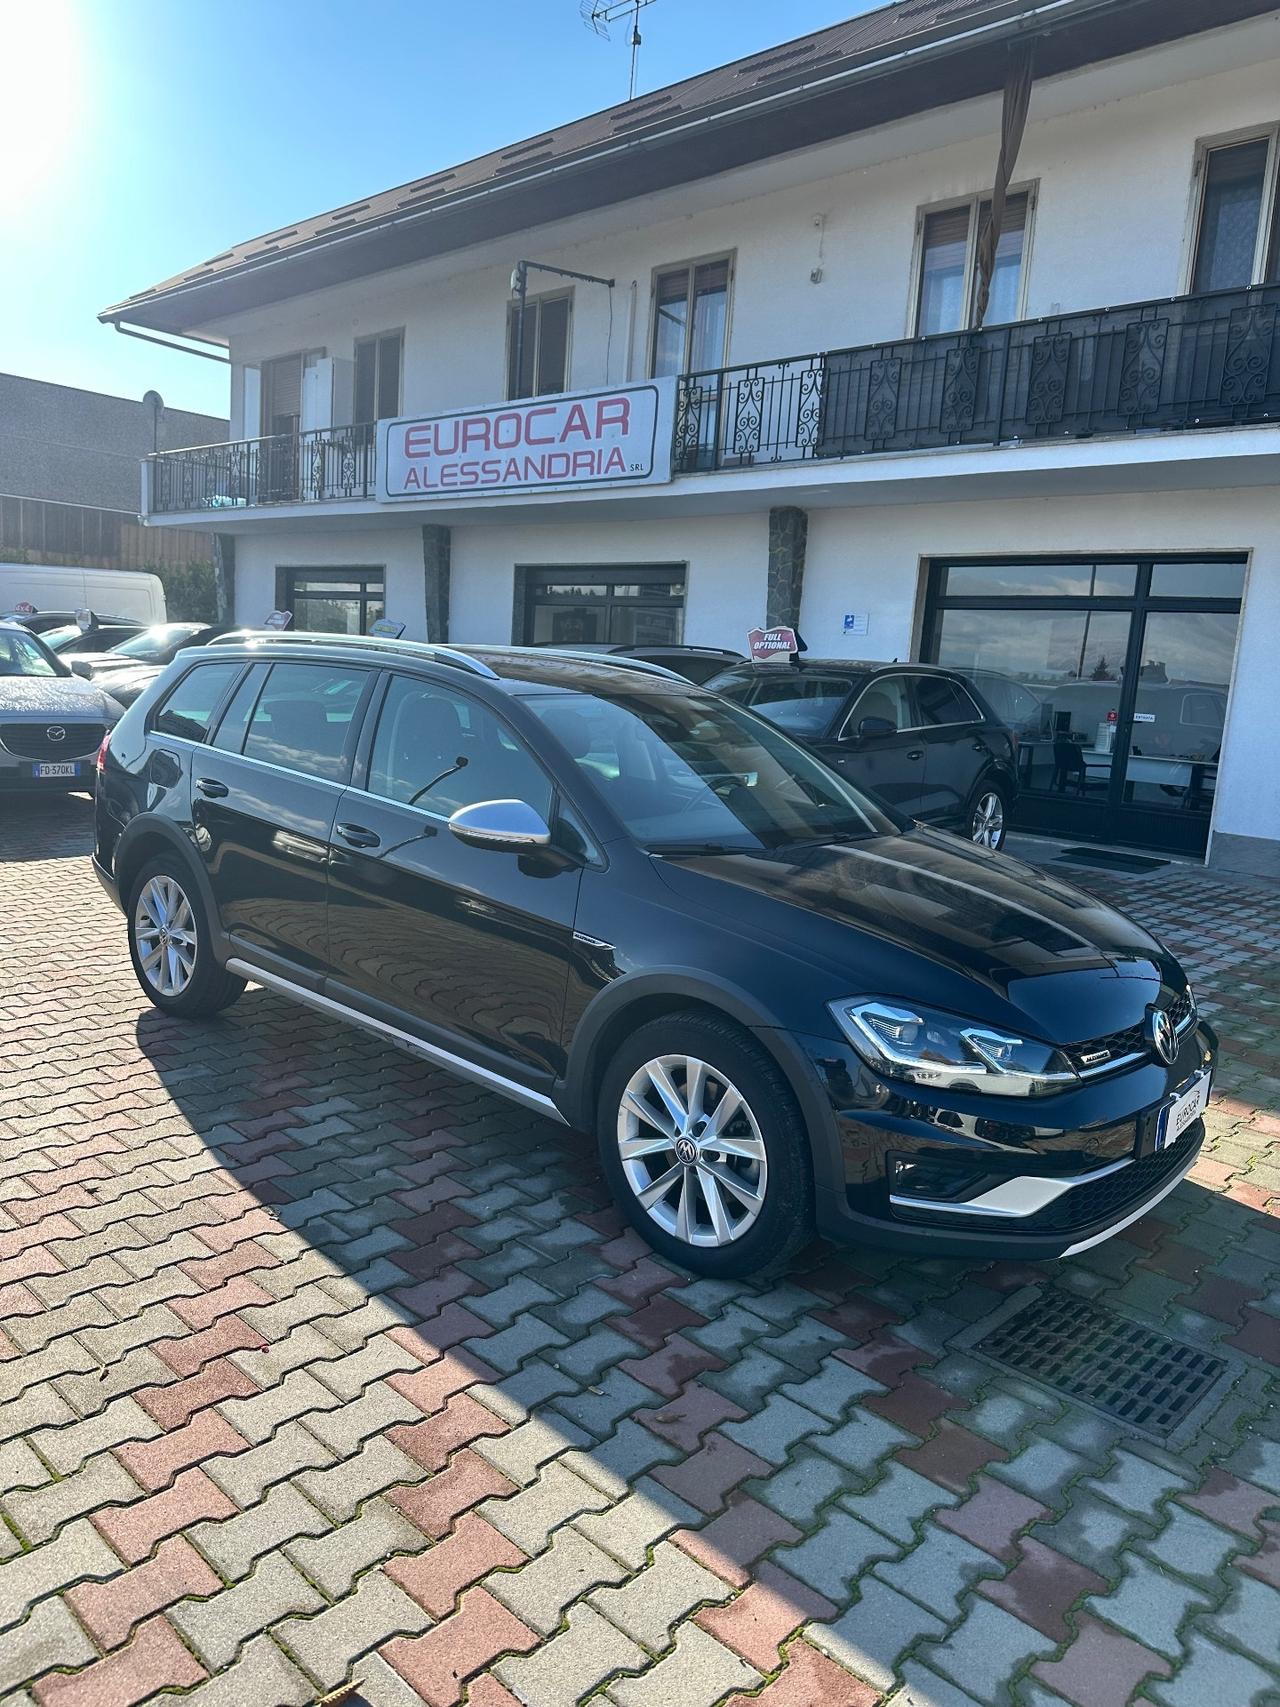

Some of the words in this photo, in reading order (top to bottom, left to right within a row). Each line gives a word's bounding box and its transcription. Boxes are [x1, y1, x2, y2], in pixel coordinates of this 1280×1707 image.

[404, 397, 631, 459] EUROCAR
[403, 447, 627, 490] ALESSANDRIA
[629, 463, 645, 472] SRL
[753, 641, 791, 650] OPTIONAL
[764, 633, 782, 641] FULL
